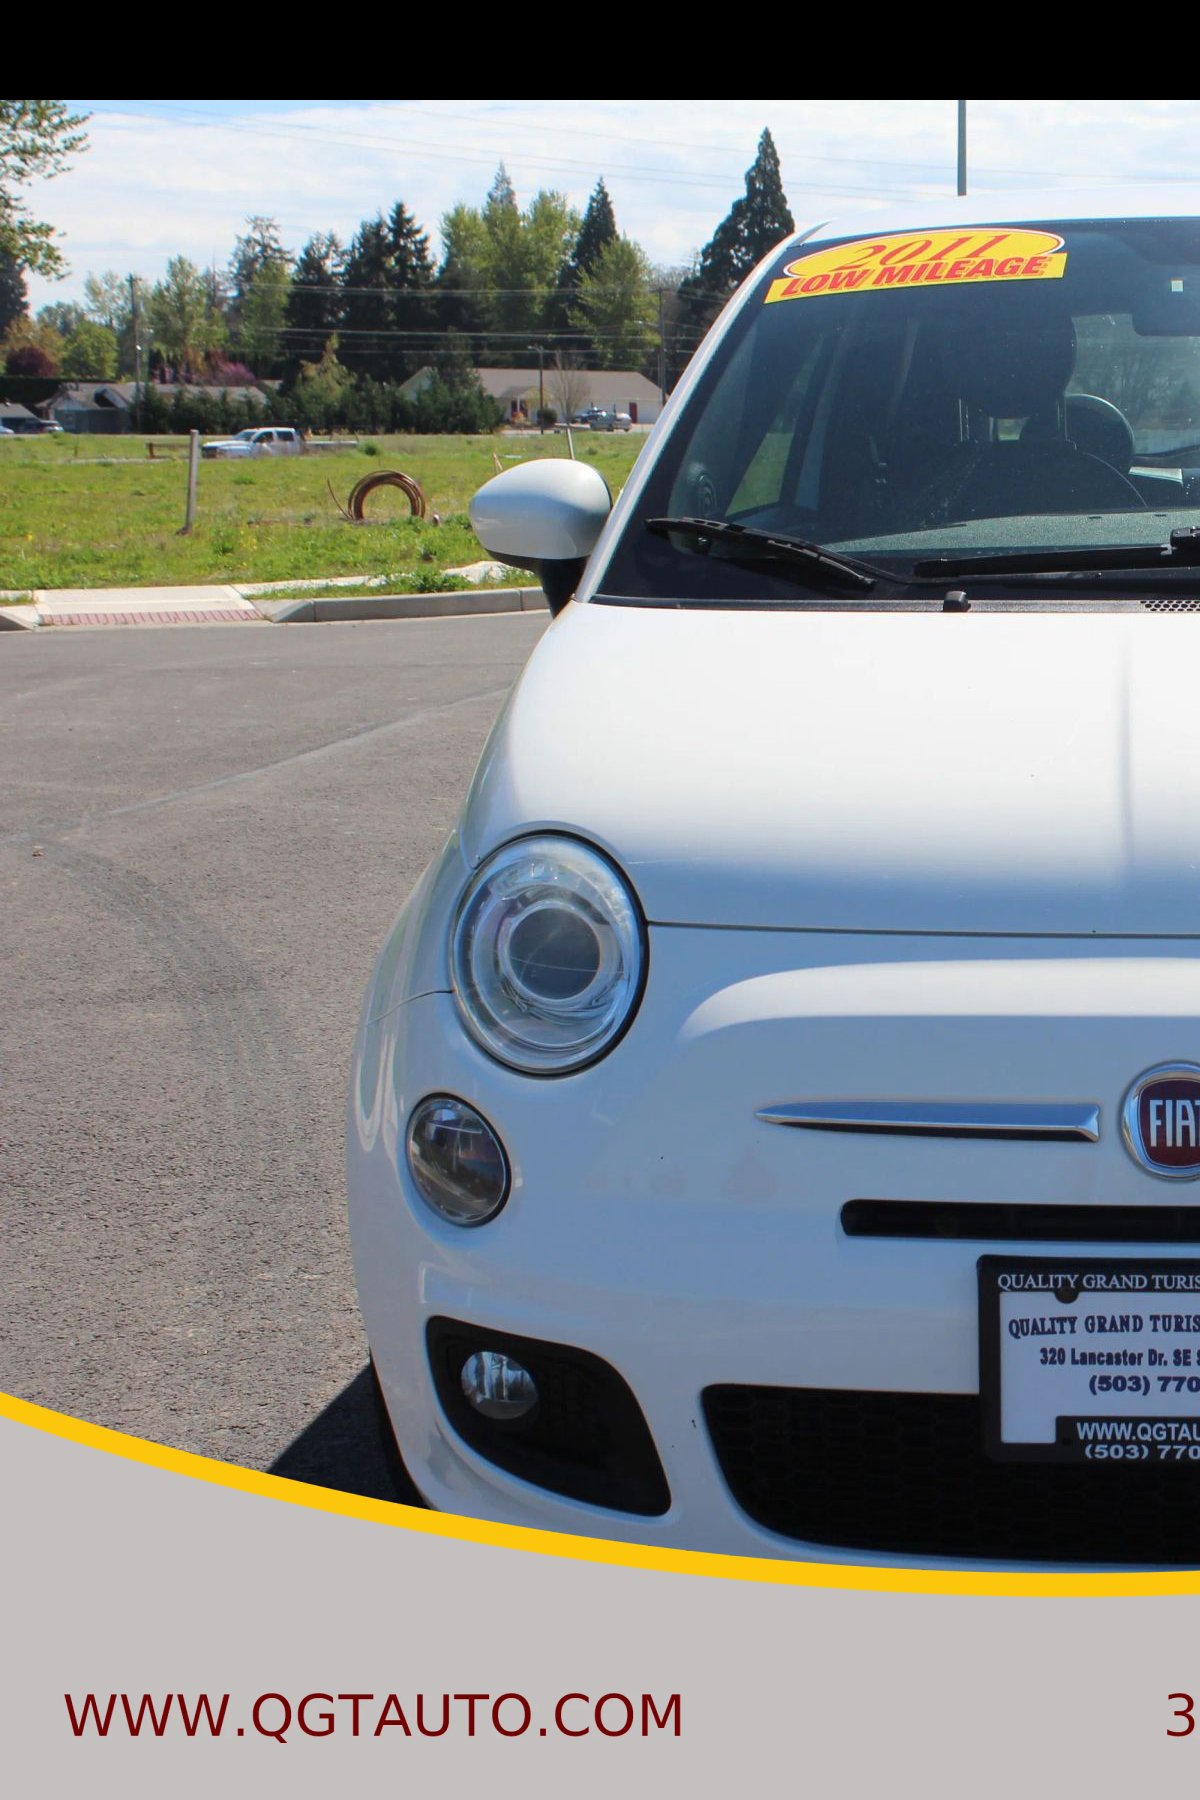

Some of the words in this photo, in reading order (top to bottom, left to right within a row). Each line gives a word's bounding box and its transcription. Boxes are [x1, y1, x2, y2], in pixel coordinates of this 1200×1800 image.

[831, 233, 1011, 272] 2011
[780, 267, 870, 298] LOW
[872, 255, 1050, 286] MILEAGE
[997, 1274, 1079, 1291] QUALITY
[1082, 1275, 1148, 1290] GRAND
[1008, 1315, 1078, 1339] QUALITY
[1084, 1314, 1144, 1334] GRAND
[1039, 1347, 1066, 1366] 320
[1070, 1347, 1144, 1367] Lancaster
[1147, 1348, 1168, 1367] Dr.
[1172, 1348, 1192, 1367] SE
[1088, 1374, 1151, 1396] (503)
[1084, 1444, 1149, 1460] (503)
